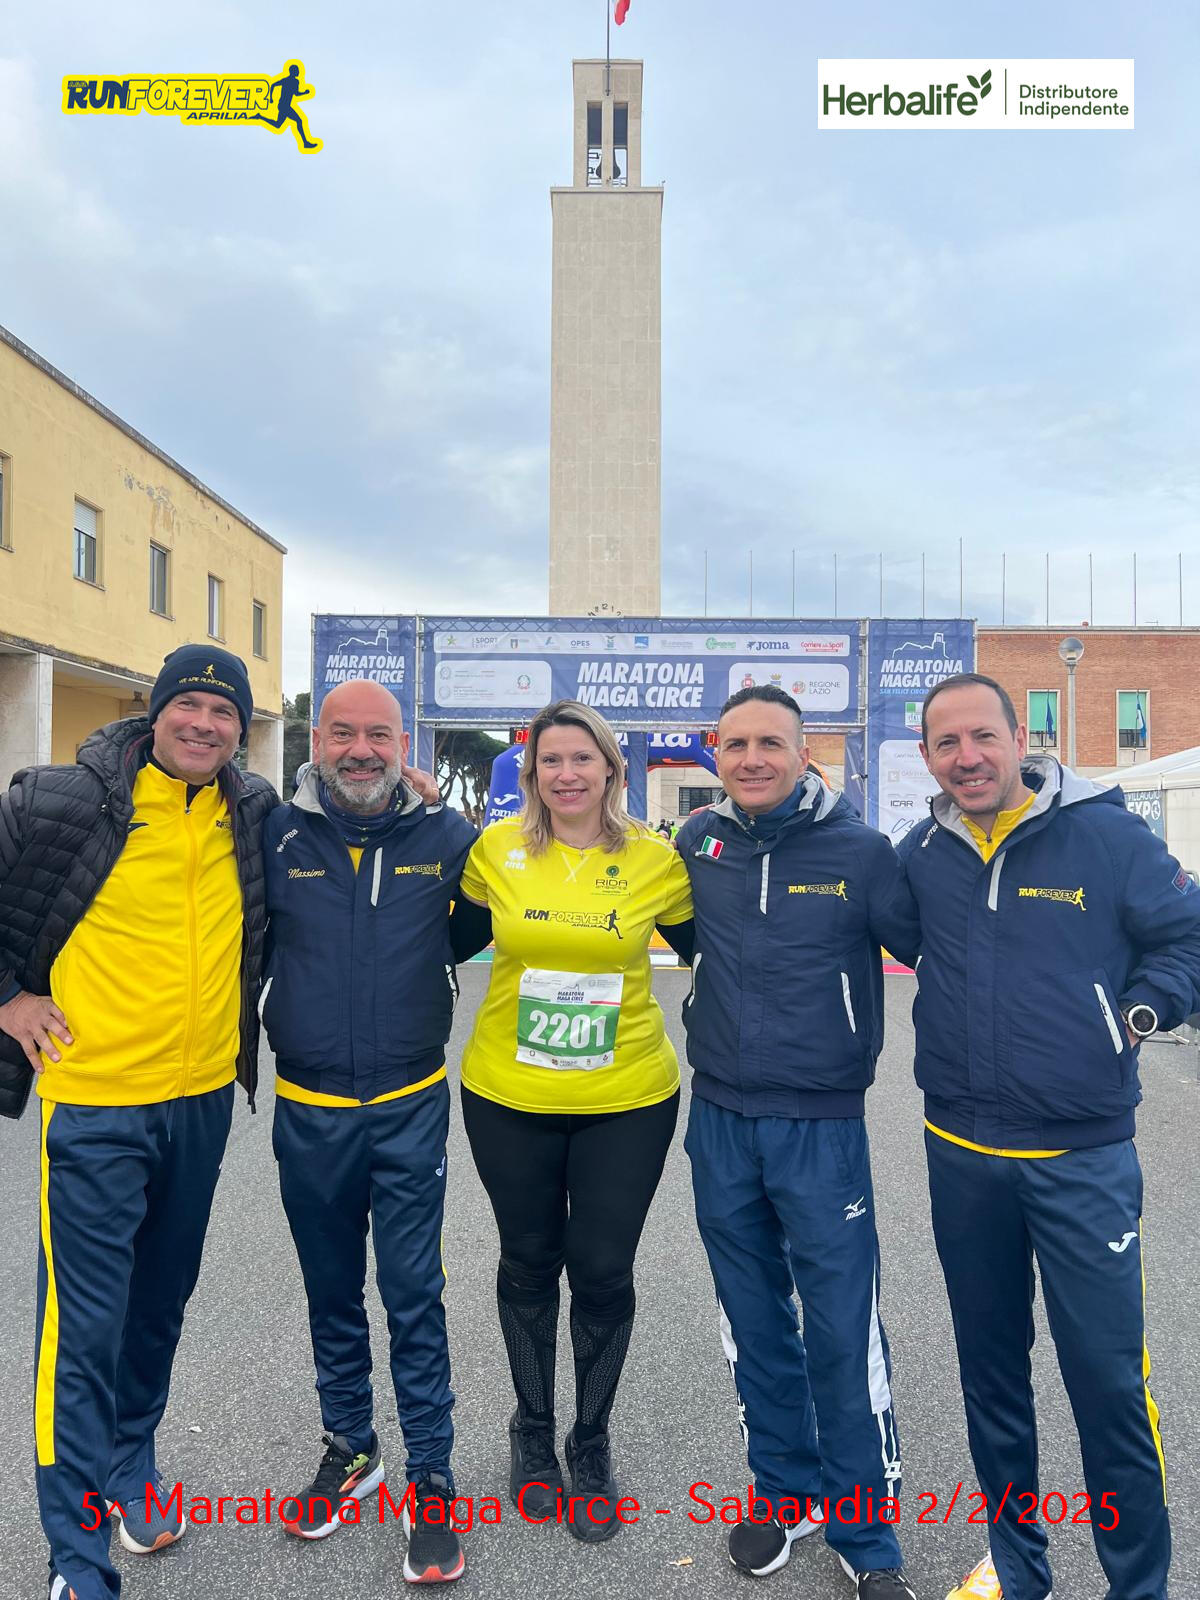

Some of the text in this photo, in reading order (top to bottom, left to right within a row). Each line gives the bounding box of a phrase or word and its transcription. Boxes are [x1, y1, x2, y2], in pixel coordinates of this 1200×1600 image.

[326, 655, 405, 669] MARATONA
[881, 659, 963, 673] MARATONA
[325, 669, 405, 683] MAGA CIRCE
[577, 662, 704, 684] MARATONA
[880, 673, 921, 688] MAGA
[576, 685, 704, 708] MAGA CIRCE
[1127, 800, 1161, 820] EXPO
[288, 868, 326, 879] Massimo
[595, 879, 628, 887] RIDA
[527, 1009, 607, 1049] 2201
